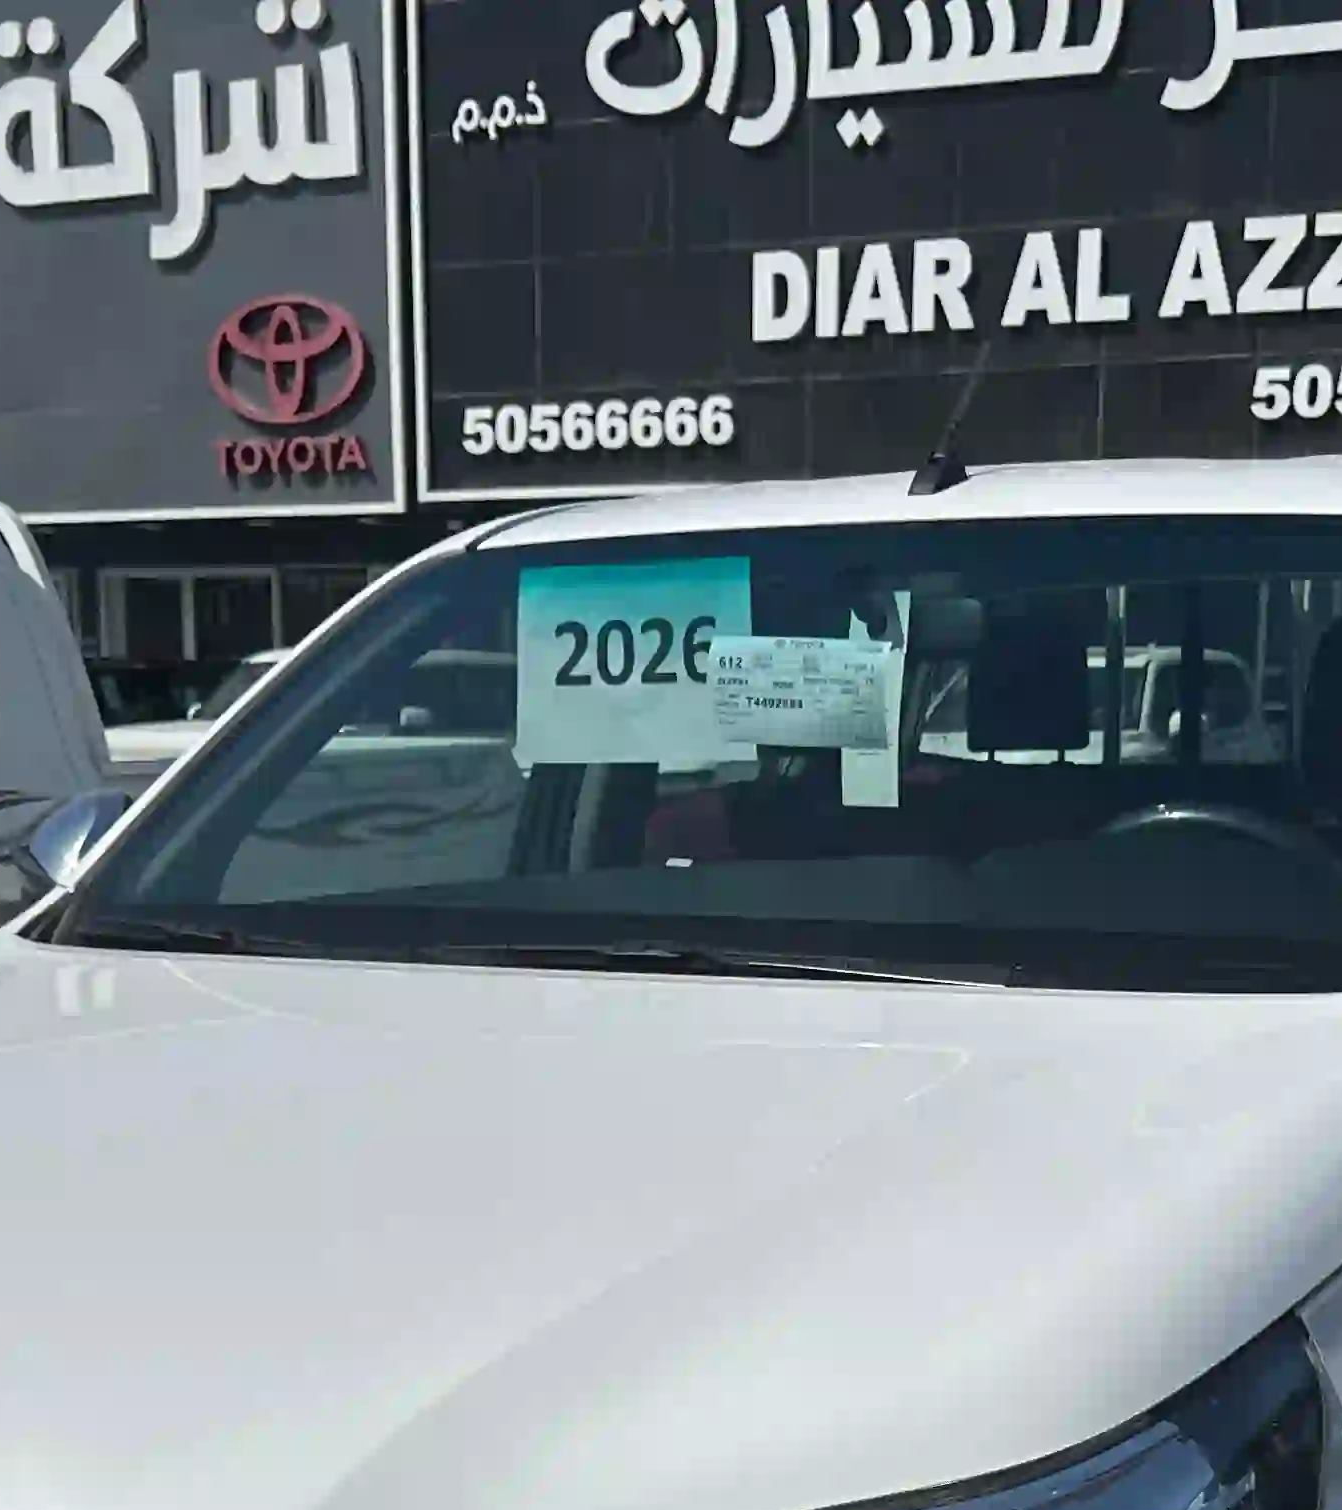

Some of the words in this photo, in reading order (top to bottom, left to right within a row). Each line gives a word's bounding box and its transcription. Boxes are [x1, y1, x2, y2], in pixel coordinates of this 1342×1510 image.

[752, 238, 974, 341] DIAR
[1000, 227, 1130, 327] AL
[214, 432, 367, 476] TOYOTA
[462, 394, 735, 455] 50566666
[554, 615, 717, 687] 2026
